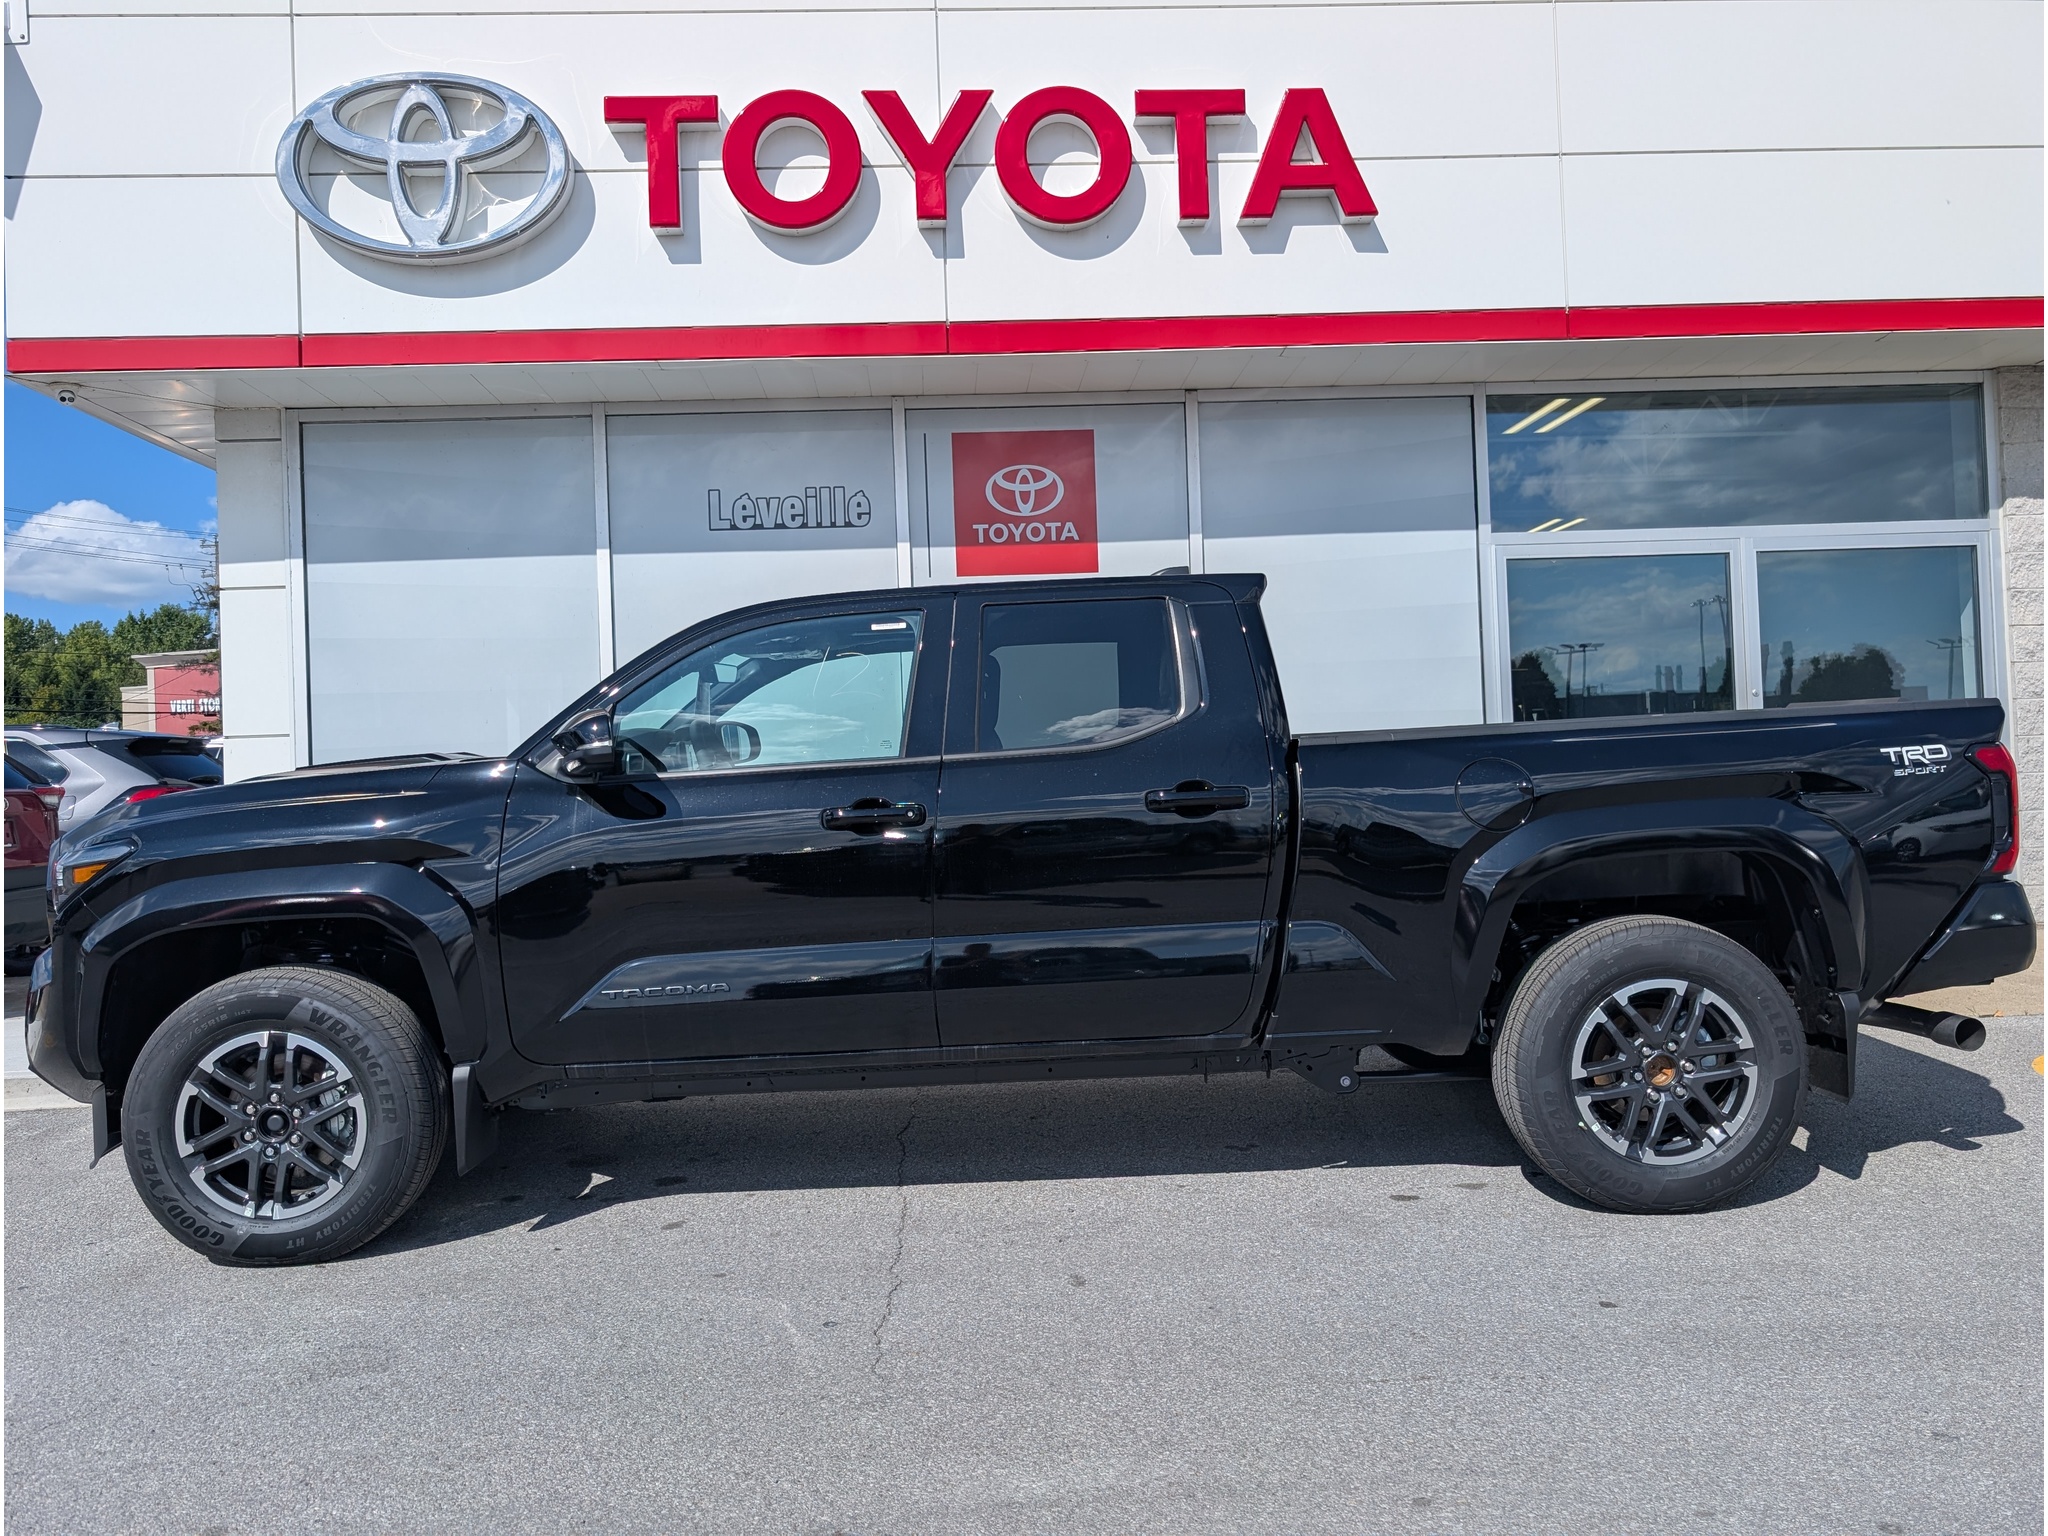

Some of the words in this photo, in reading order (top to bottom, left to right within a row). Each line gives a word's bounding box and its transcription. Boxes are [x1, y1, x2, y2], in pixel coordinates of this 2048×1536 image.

[604, 86, 1380, 235] TOYOTA
[708, 486, 872, 531] Léveillé
[972, 521, 1080, 544] TOYOTA
[170, 698, 195, 713] VERTI
[1880, 744, 1949, 767] TRD
[1894, 765, 1947, 777] SPORT
[601, 982, 731, 1000] TACOMA
[170, 1013, 229, 1057] 265/65R18
[309, 1007, 398, 1124] WRANGLER
[1730, 1116, 1784, 1179] TERRITORY
[1704, 1177, 1722, 1191] HT
[315, 1183, 377, 1241] TERRITORY
[286, 1237, 306, 1249] HT
